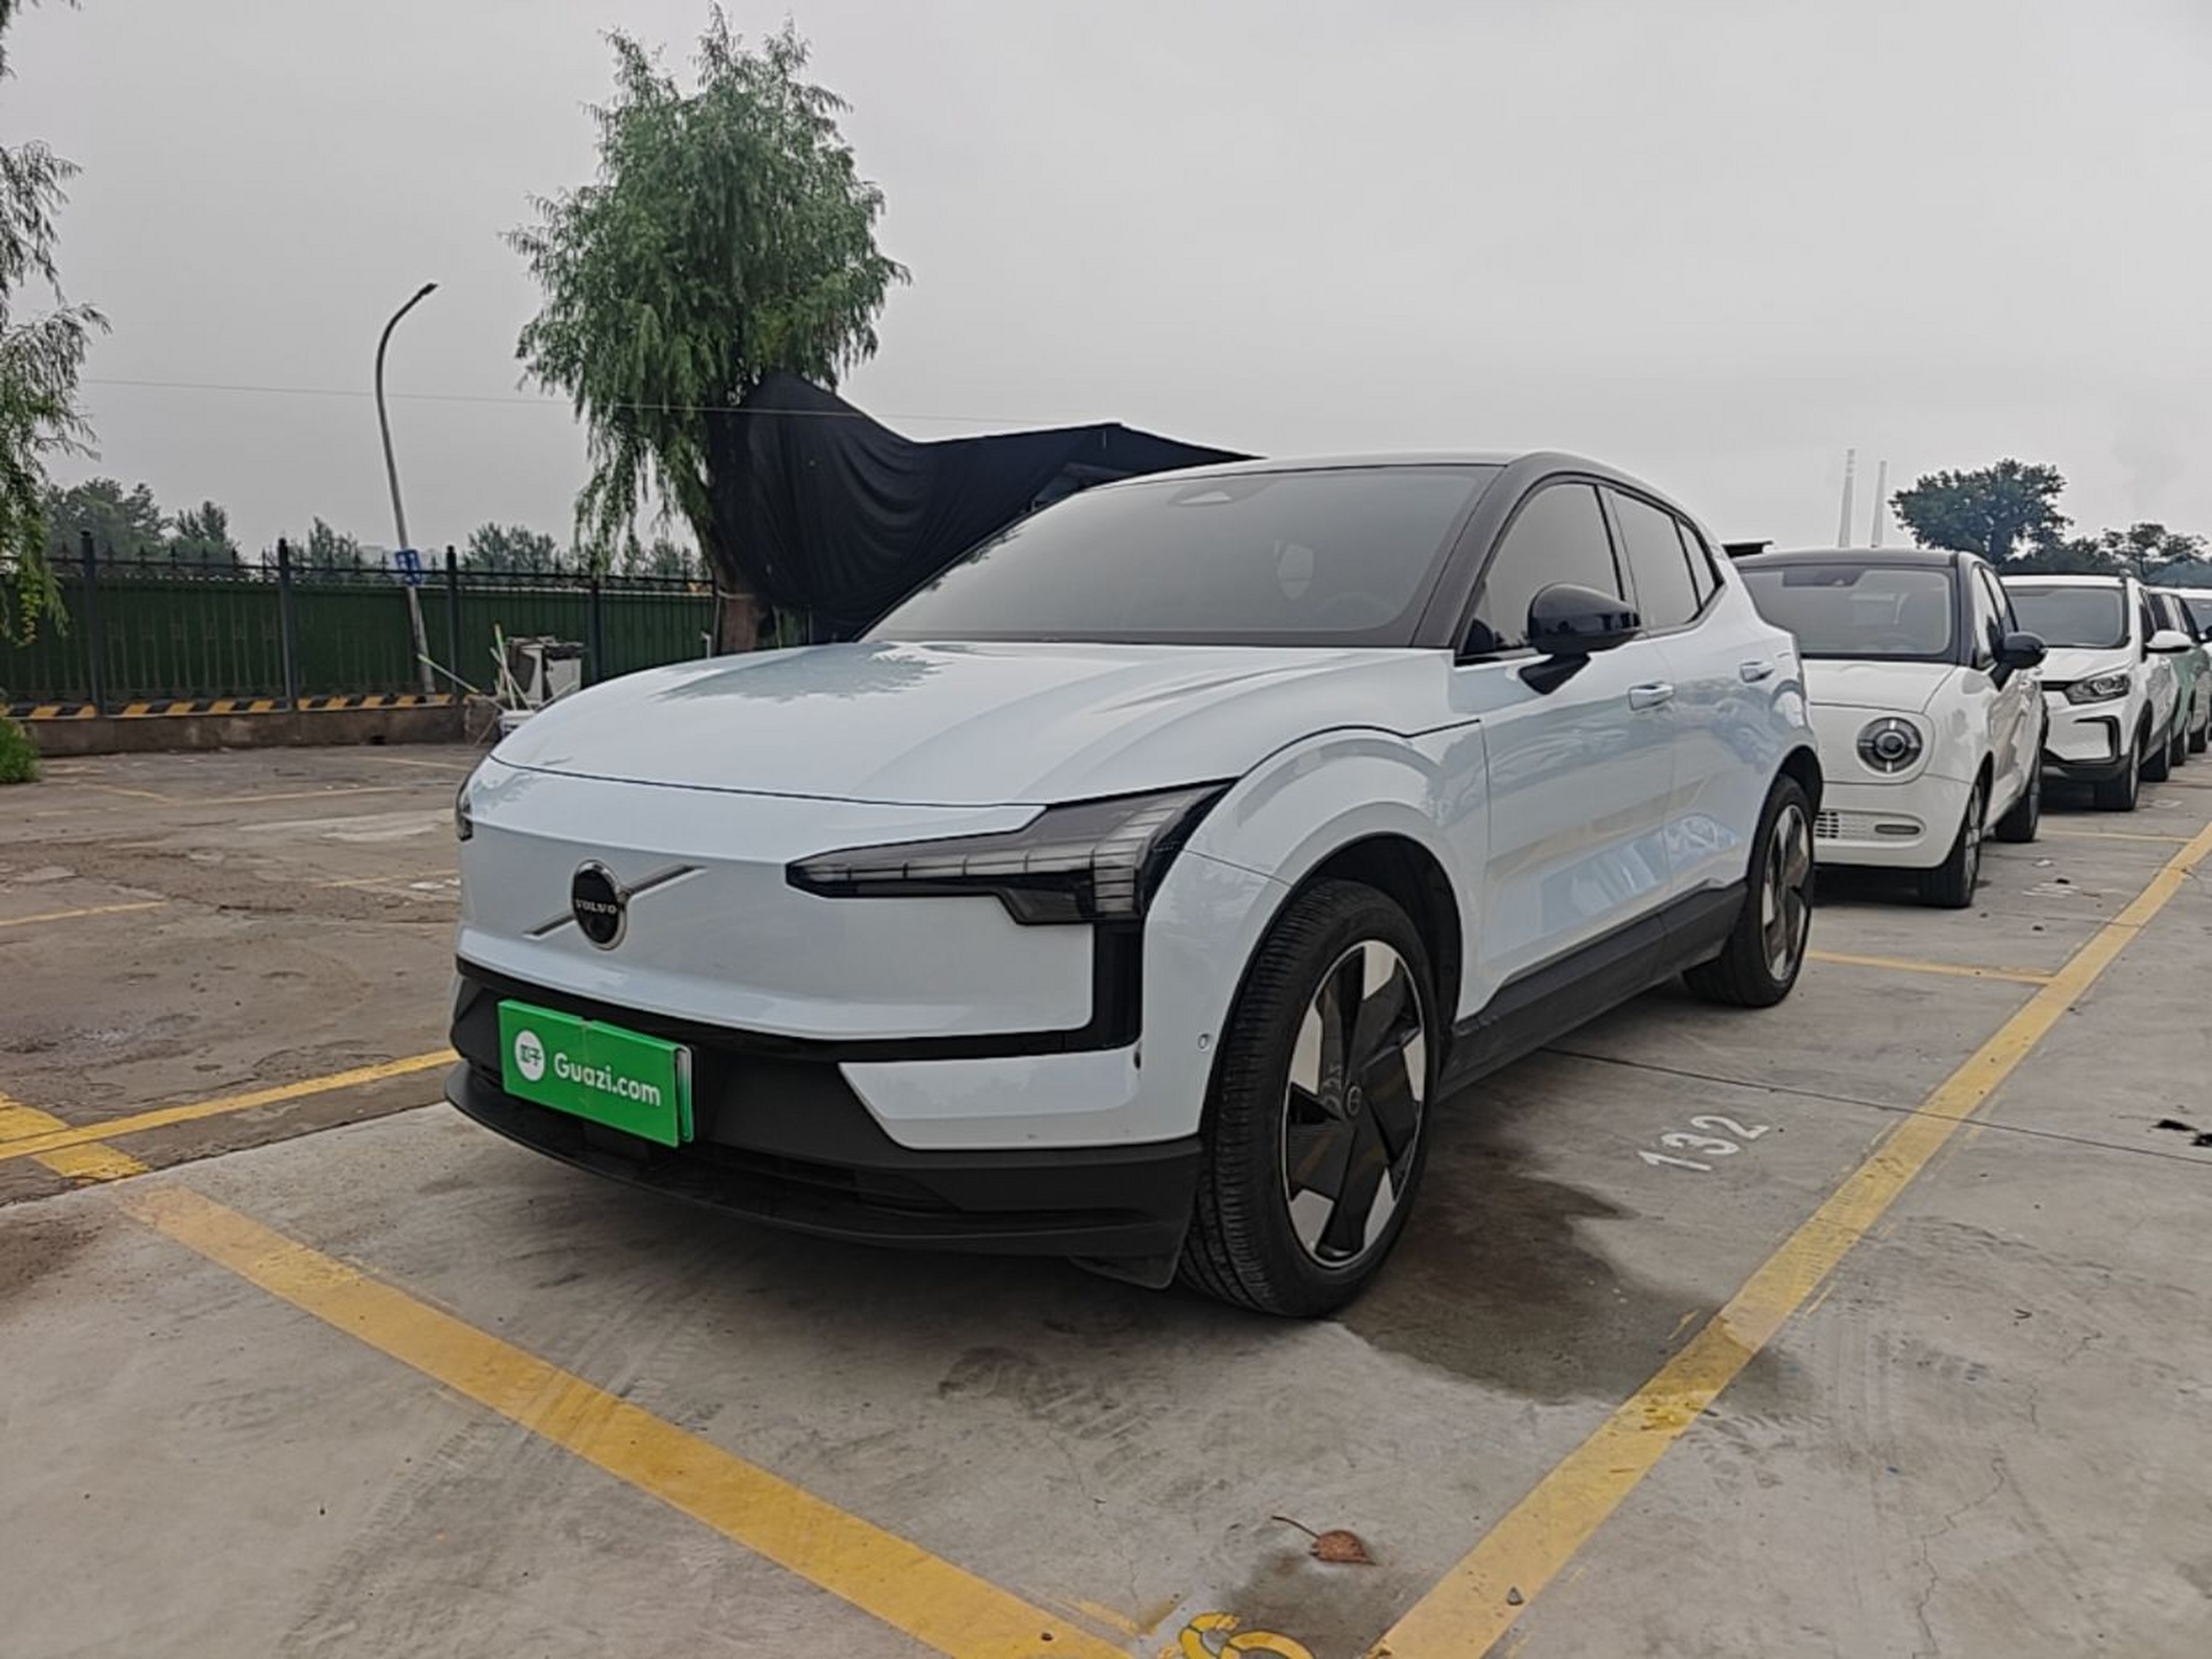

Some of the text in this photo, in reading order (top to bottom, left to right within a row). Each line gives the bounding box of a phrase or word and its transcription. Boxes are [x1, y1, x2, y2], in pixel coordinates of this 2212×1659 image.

[575, 898, 617, 914] VOLVO
[554, 1052, 661, 1107] Guazi.com
[1638, 1115, 1770, 1172] 132
